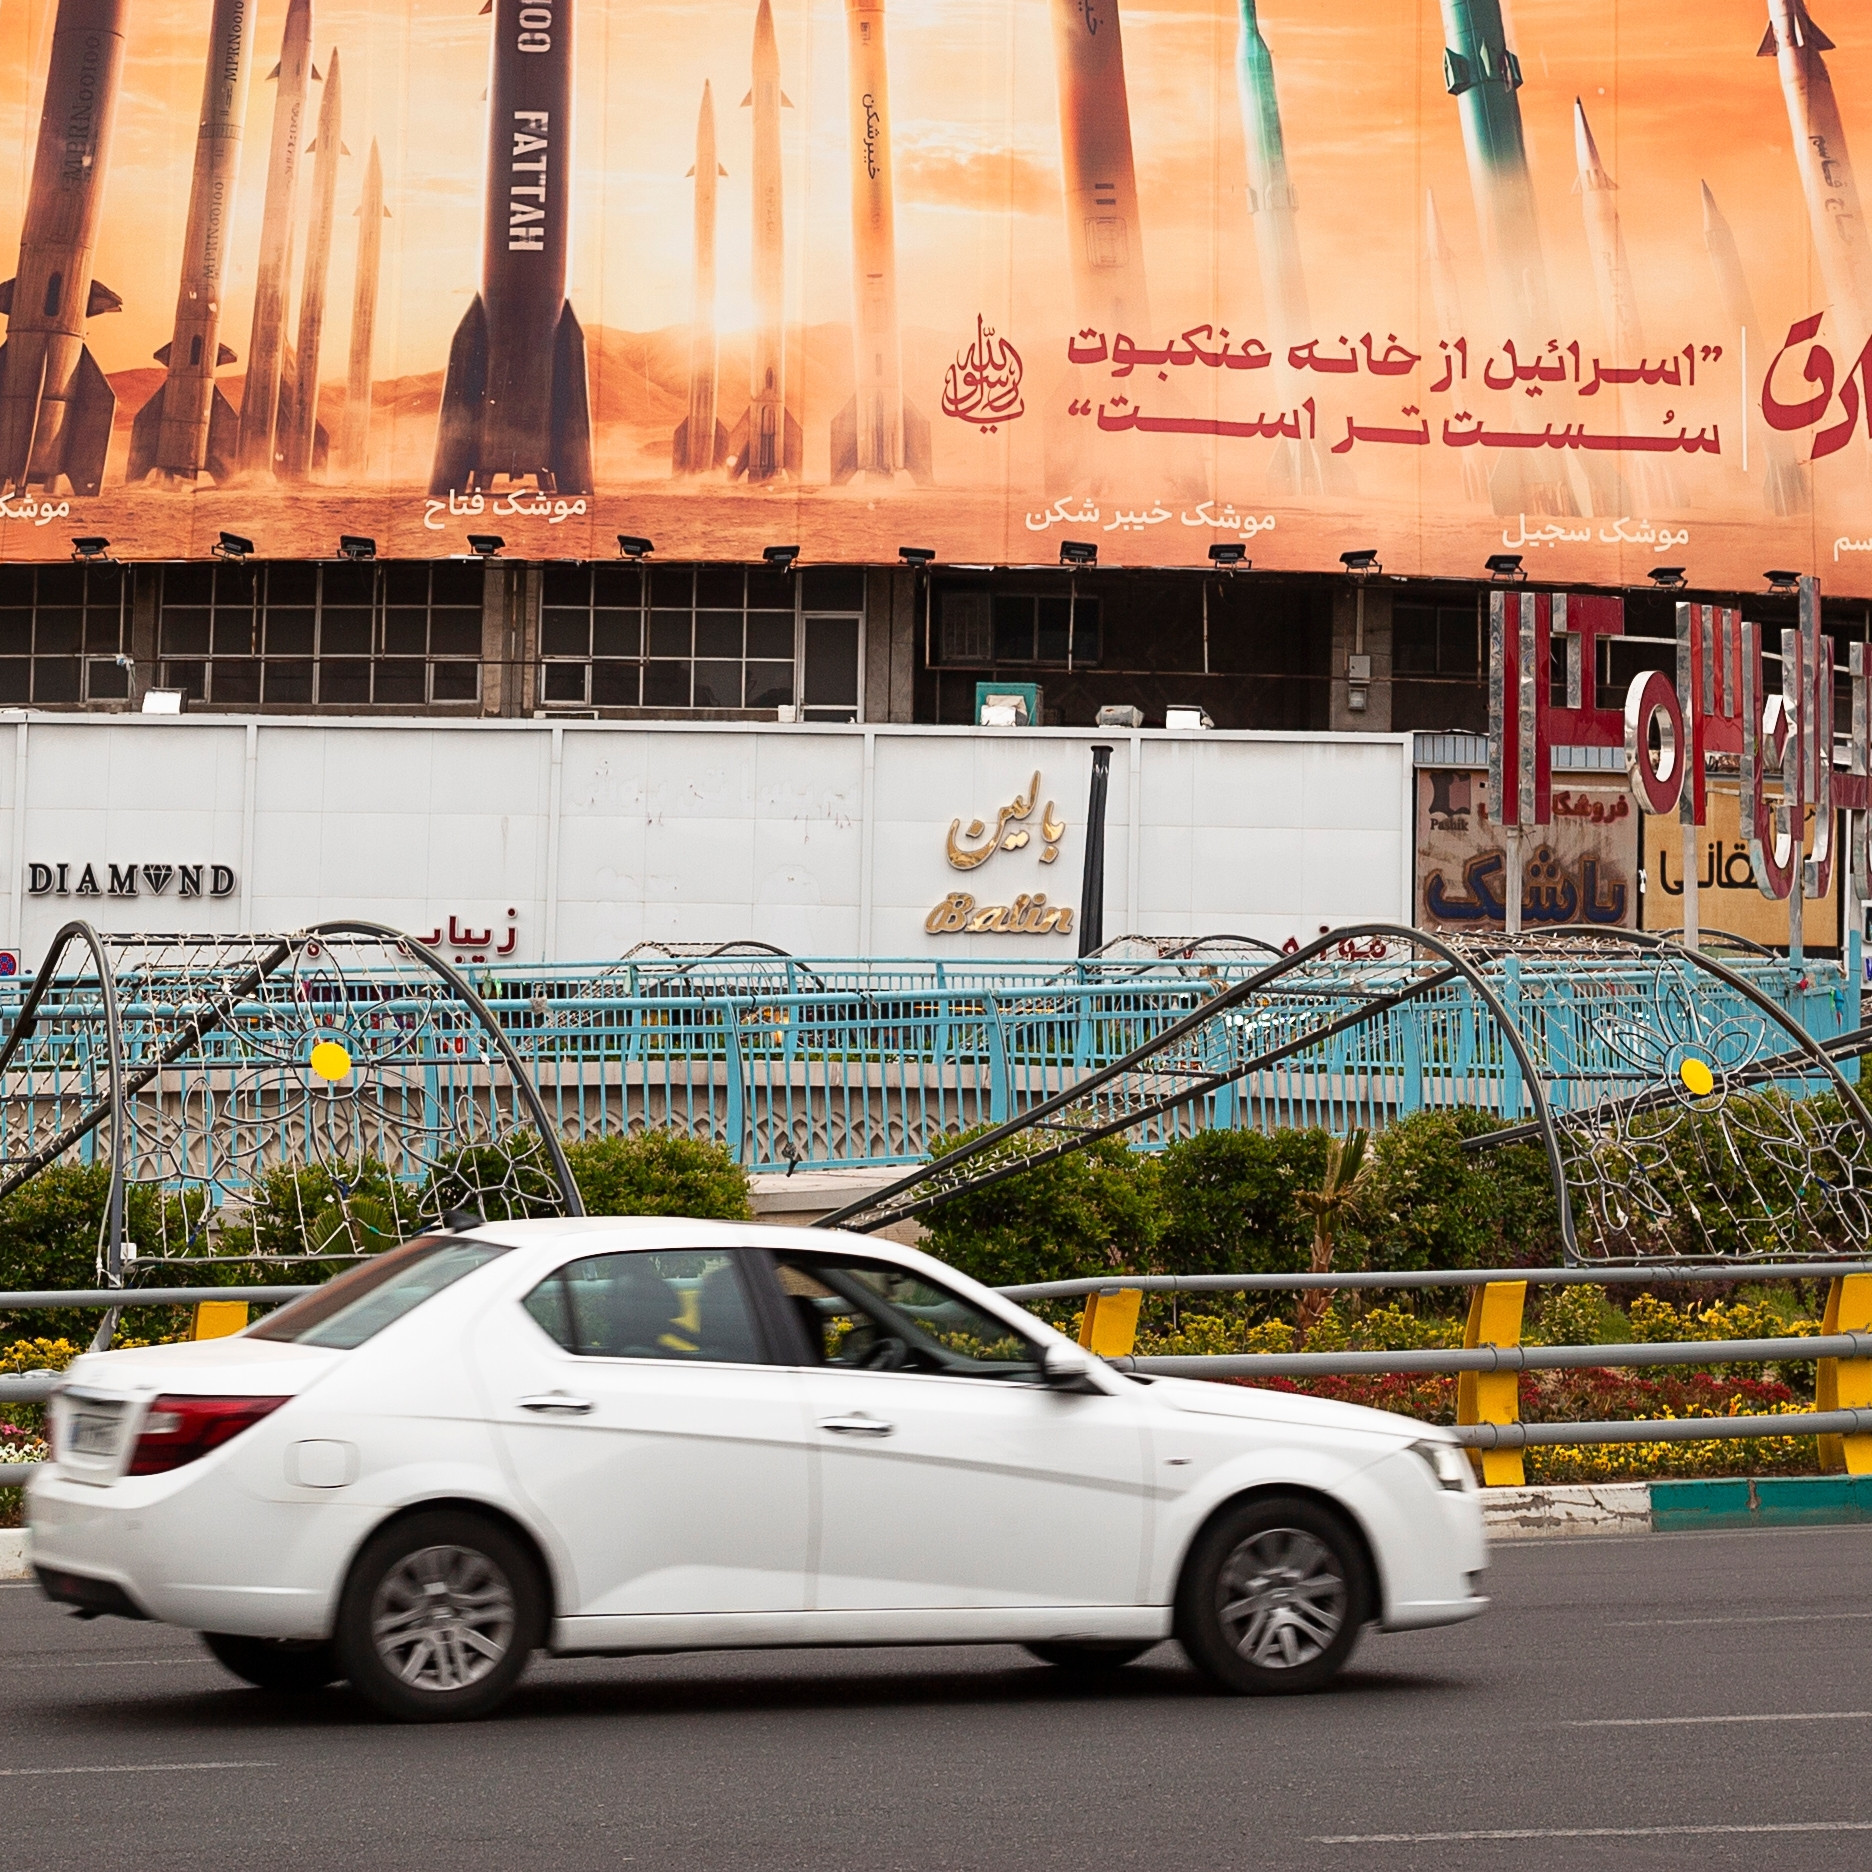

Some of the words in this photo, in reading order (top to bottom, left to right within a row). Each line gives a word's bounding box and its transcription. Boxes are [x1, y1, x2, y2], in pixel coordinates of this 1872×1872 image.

[507, 109, 548, 251] FATTAH
[1067, 323, 1274, 379] عنکبوت
[1286, 331, 1423, 376] خانه
[1429, 336, 1468, 393] از
[1330, 403, 1431, 454] تر
[423, 486, 485, 530] فتاح
[492, 488, 588, 524] موشک
[1180, 501, 1276, 539] موشک
[1501, 502, 1594, 549] سجیل
[1598, 502, 1690, 553] موشک
[944, 768, 1066, 872] بالین
[924, 891, 1075, 937] Balin
